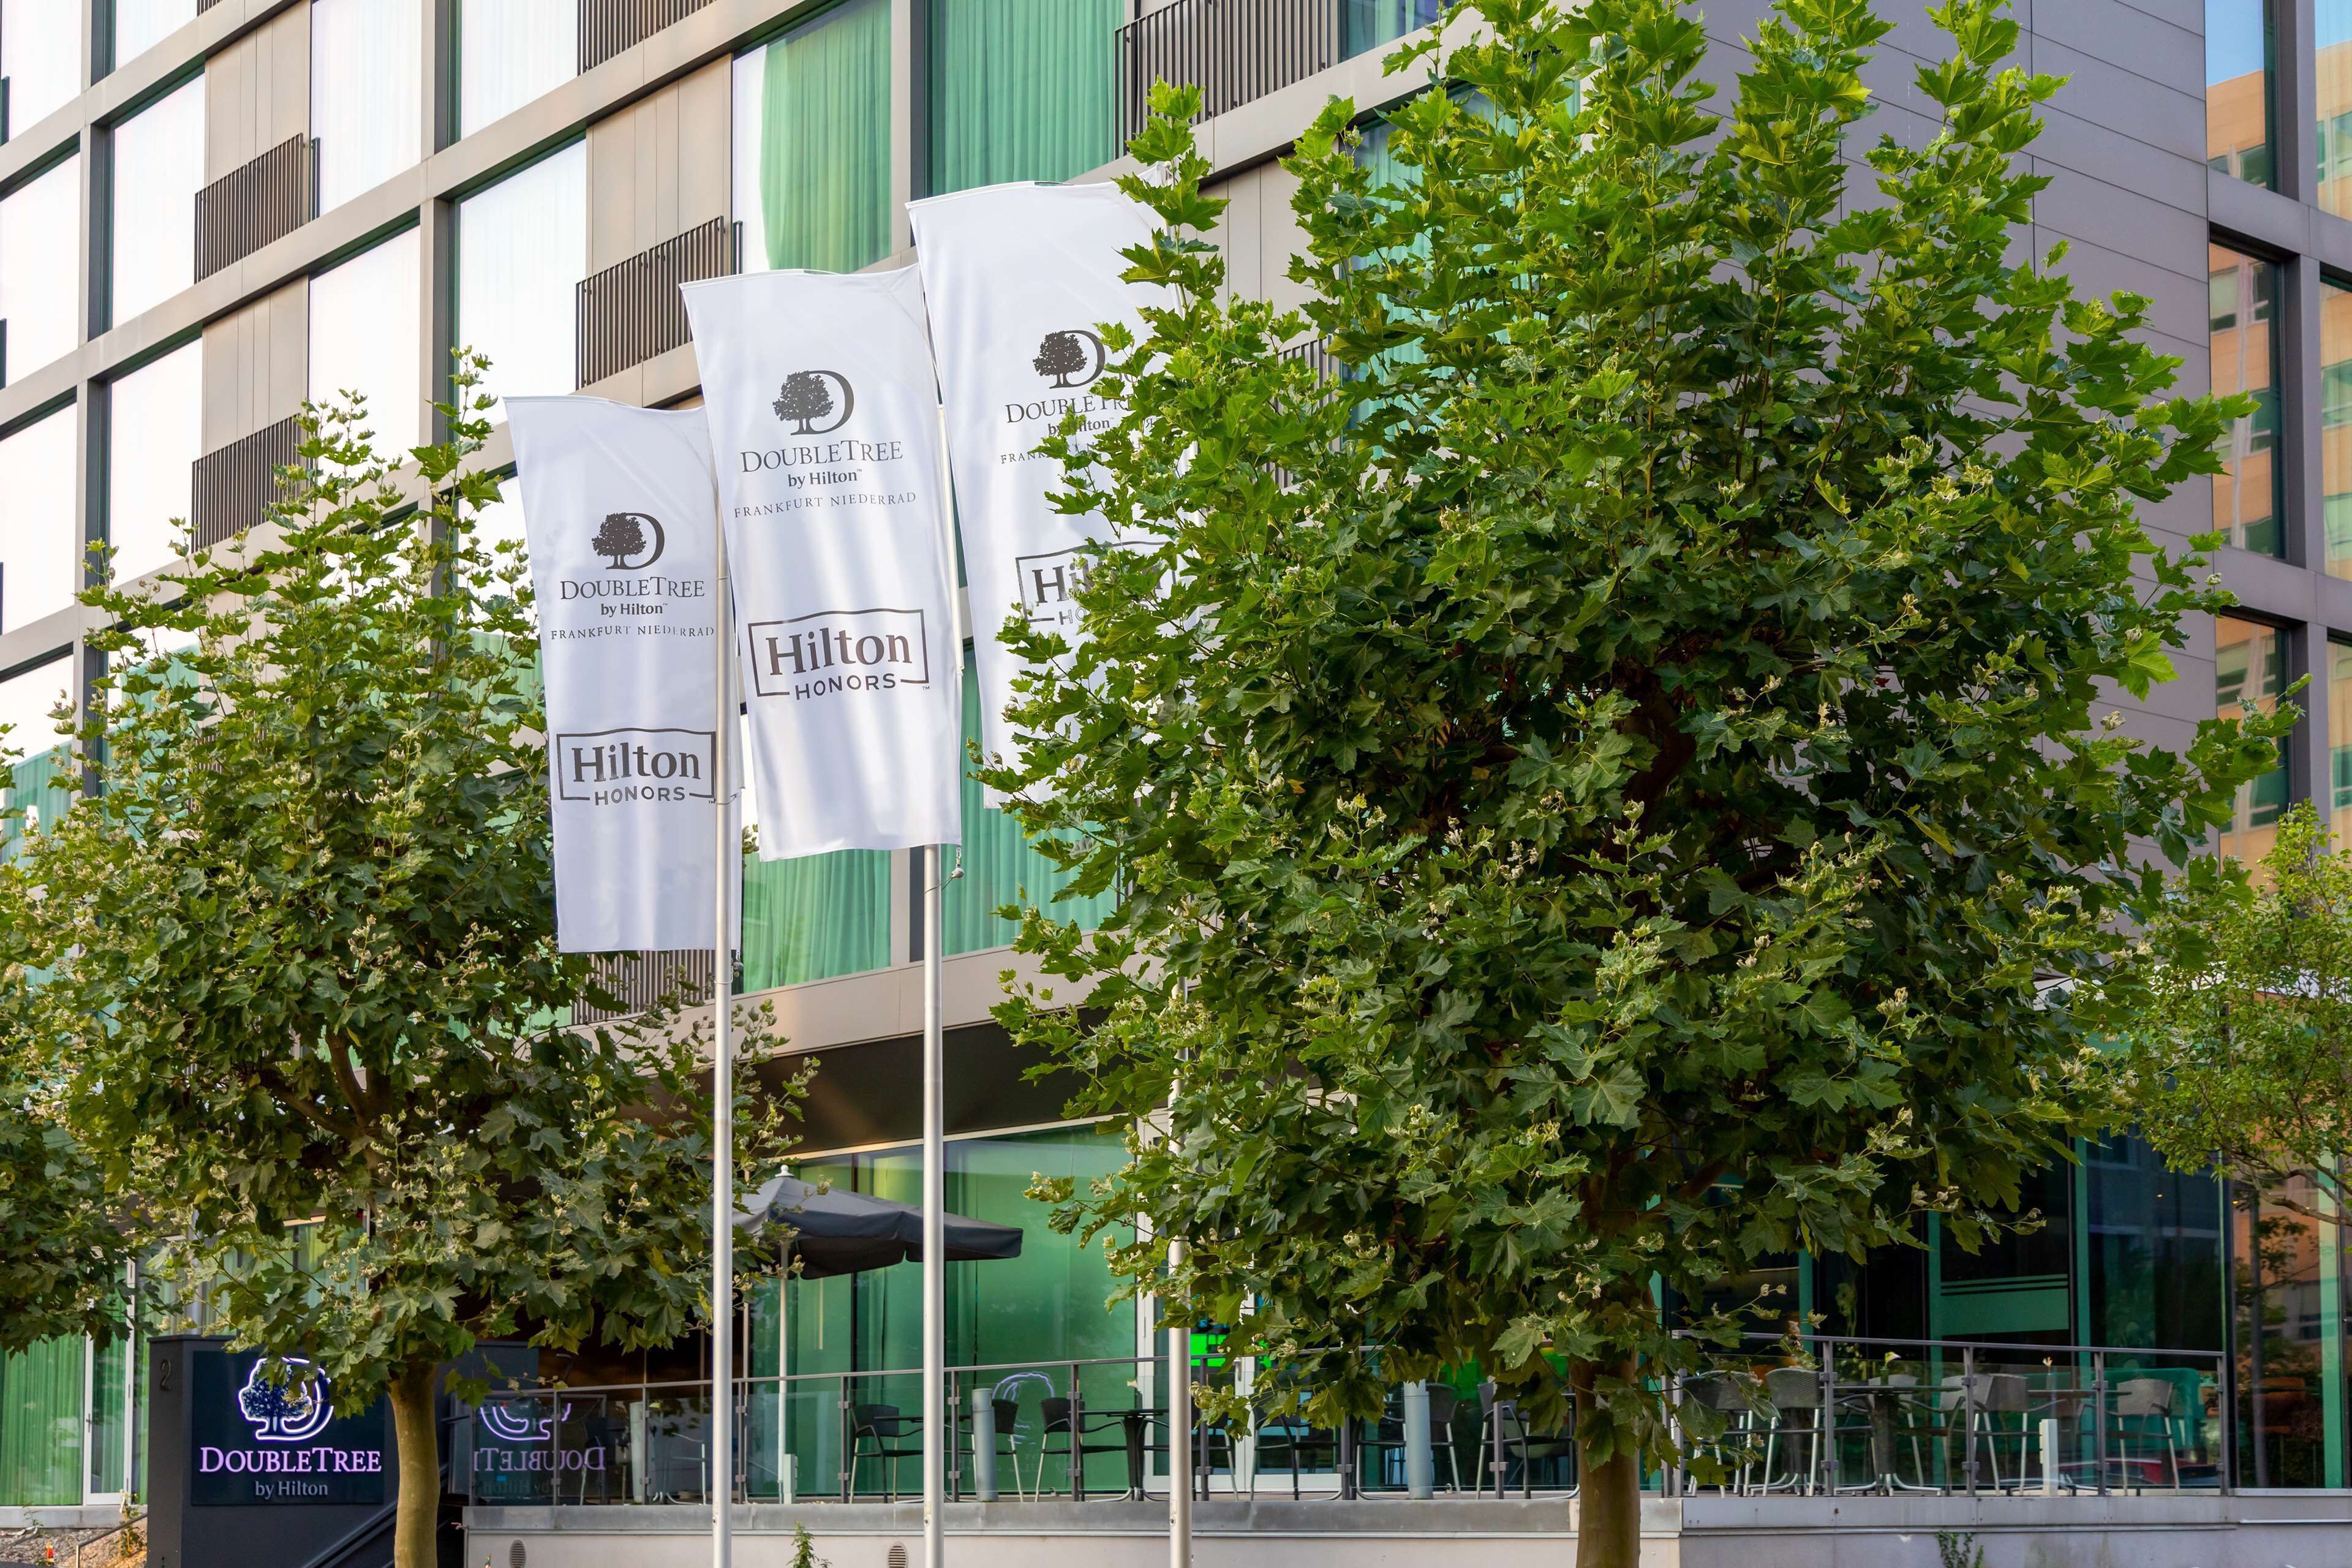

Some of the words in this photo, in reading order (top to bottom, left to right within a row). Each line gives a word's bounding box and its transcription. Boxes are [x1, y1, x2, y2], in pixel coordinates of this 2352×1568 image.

[741, 440, 903, 473] DOUBLETREE
[788, 474, 805, 489] by
[734, 497, 823, 518] FRANKFURT
[831, 492, 916, 507] NIEDERRAD
[560, 576, 706, 600] DOUBLETREE
[601, 603, 617, 617] by
[551, 625, 631, 639] FRANKFURT
[766, 627, 912, 676] Hilton
[795, 673, 896, 700] HONORS
[571, 742, 701, 782] Hilton
[595, 786, 685, 805] HONORS
[200, 1447, 382, 1472] DOUBLETREE
[255, 1480, 274, 1500] by
[278, 1480, 328, 1496] Hilton
